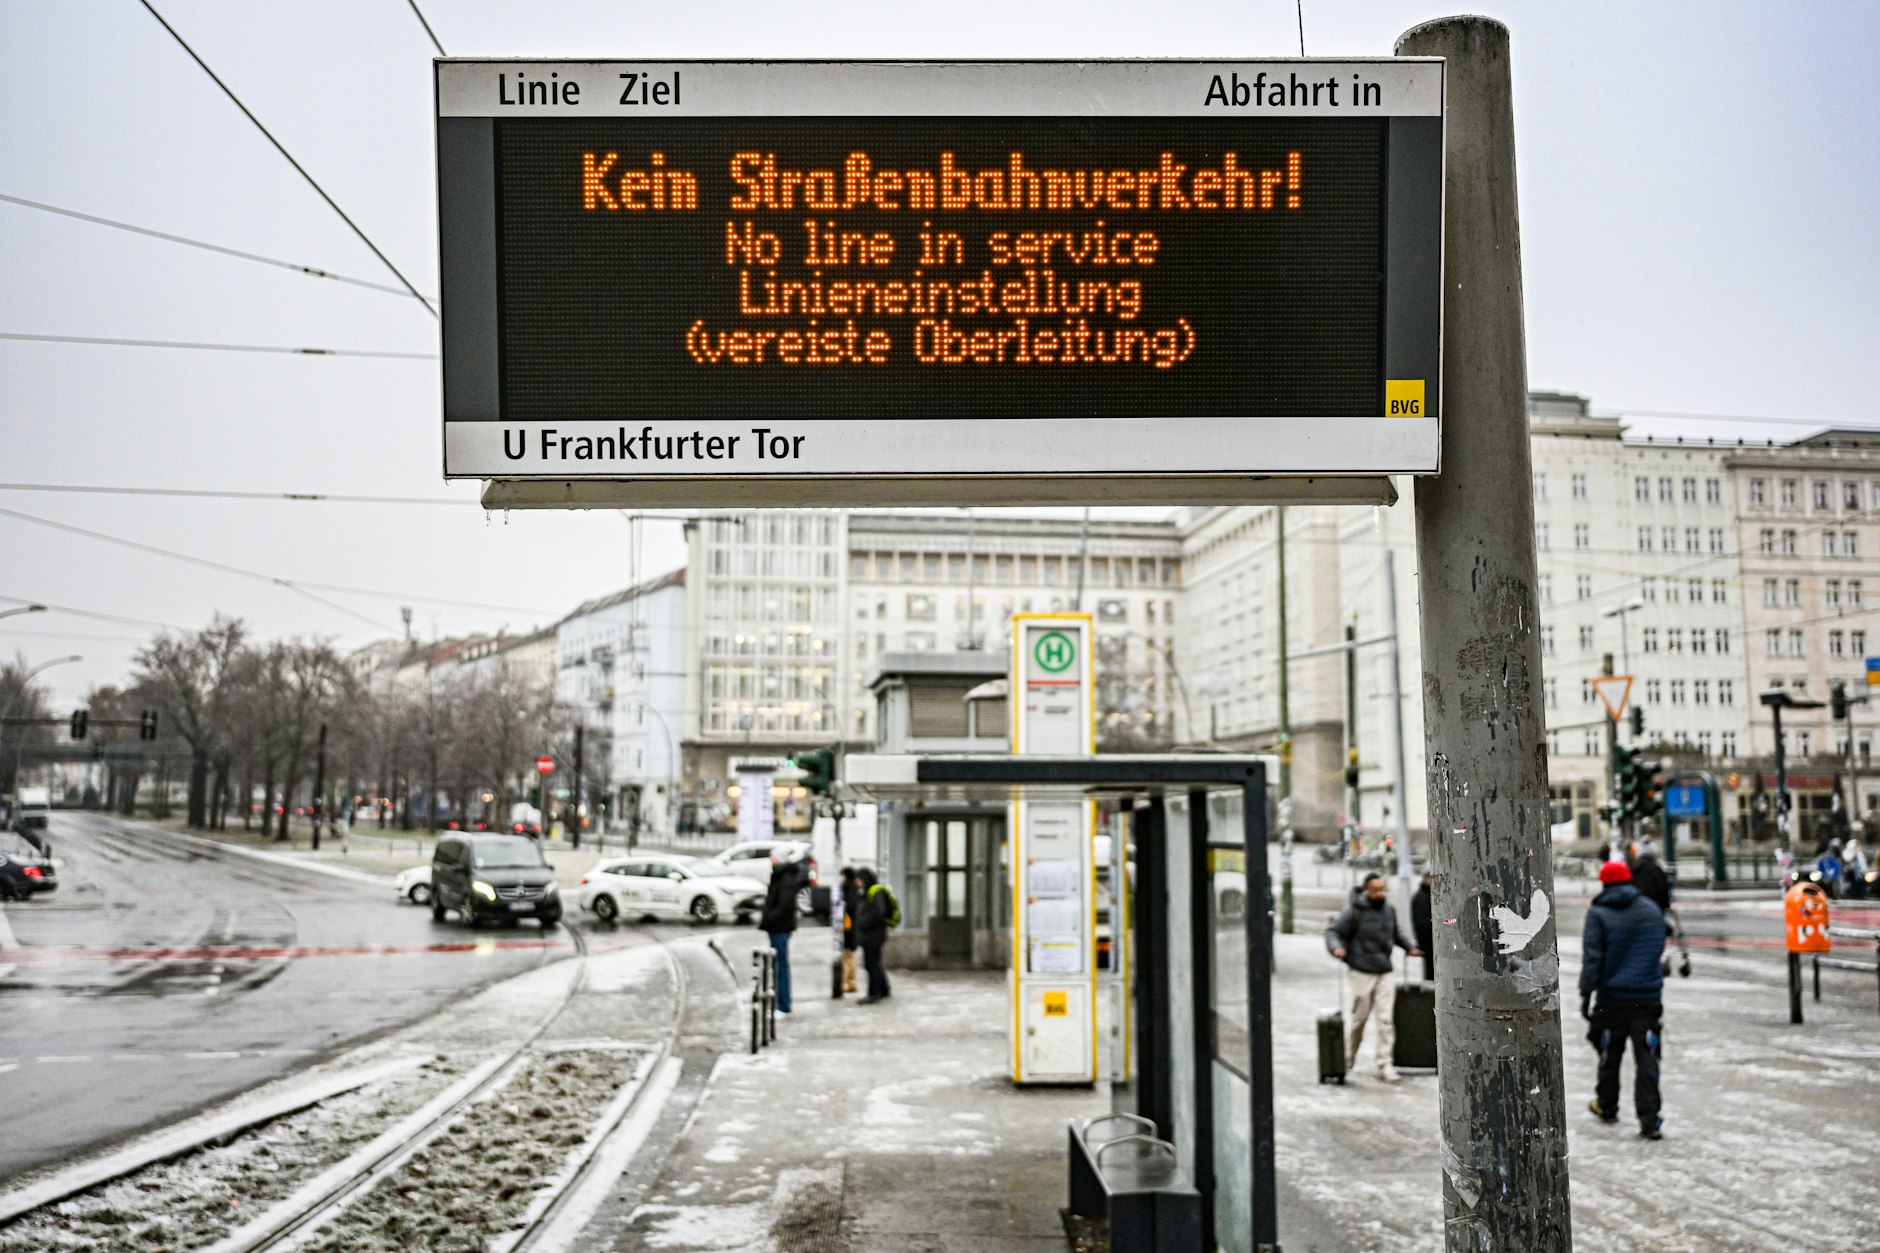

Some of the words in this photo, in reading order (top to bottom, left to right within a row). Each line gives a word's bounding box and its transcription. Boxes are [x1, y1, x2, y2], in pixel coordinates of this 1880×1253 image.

[499, 72, 580, 106] Linie
[619, 71, 680, 106] Ziel
[1204, 73, 1339, 107] Abfahrt
[1353, 73, 1381, 107] in
[582, 151, 699, 211] Kein
[729, 151, 1303, 210] Straßenbahnverkehr!
[725, 220, 782, 266] No
[802, 220, 896, 265] line
[919, 220, 964, 265] in
[988, 220, 1160, 265] service
[739, 269, 1143, 319] Linieneinstellung
[685, 319, 892, 365] (vereiste
[913, 318, 1197, 369] Oberleitung)
[1390, 399, 1420, 415] BVG
[503, 429, 526, 460] U
[541, 426, 740, 460] Frankfurter
[751, 428, 805, 460] Tor
[1045, 642, 1063, 663] H
